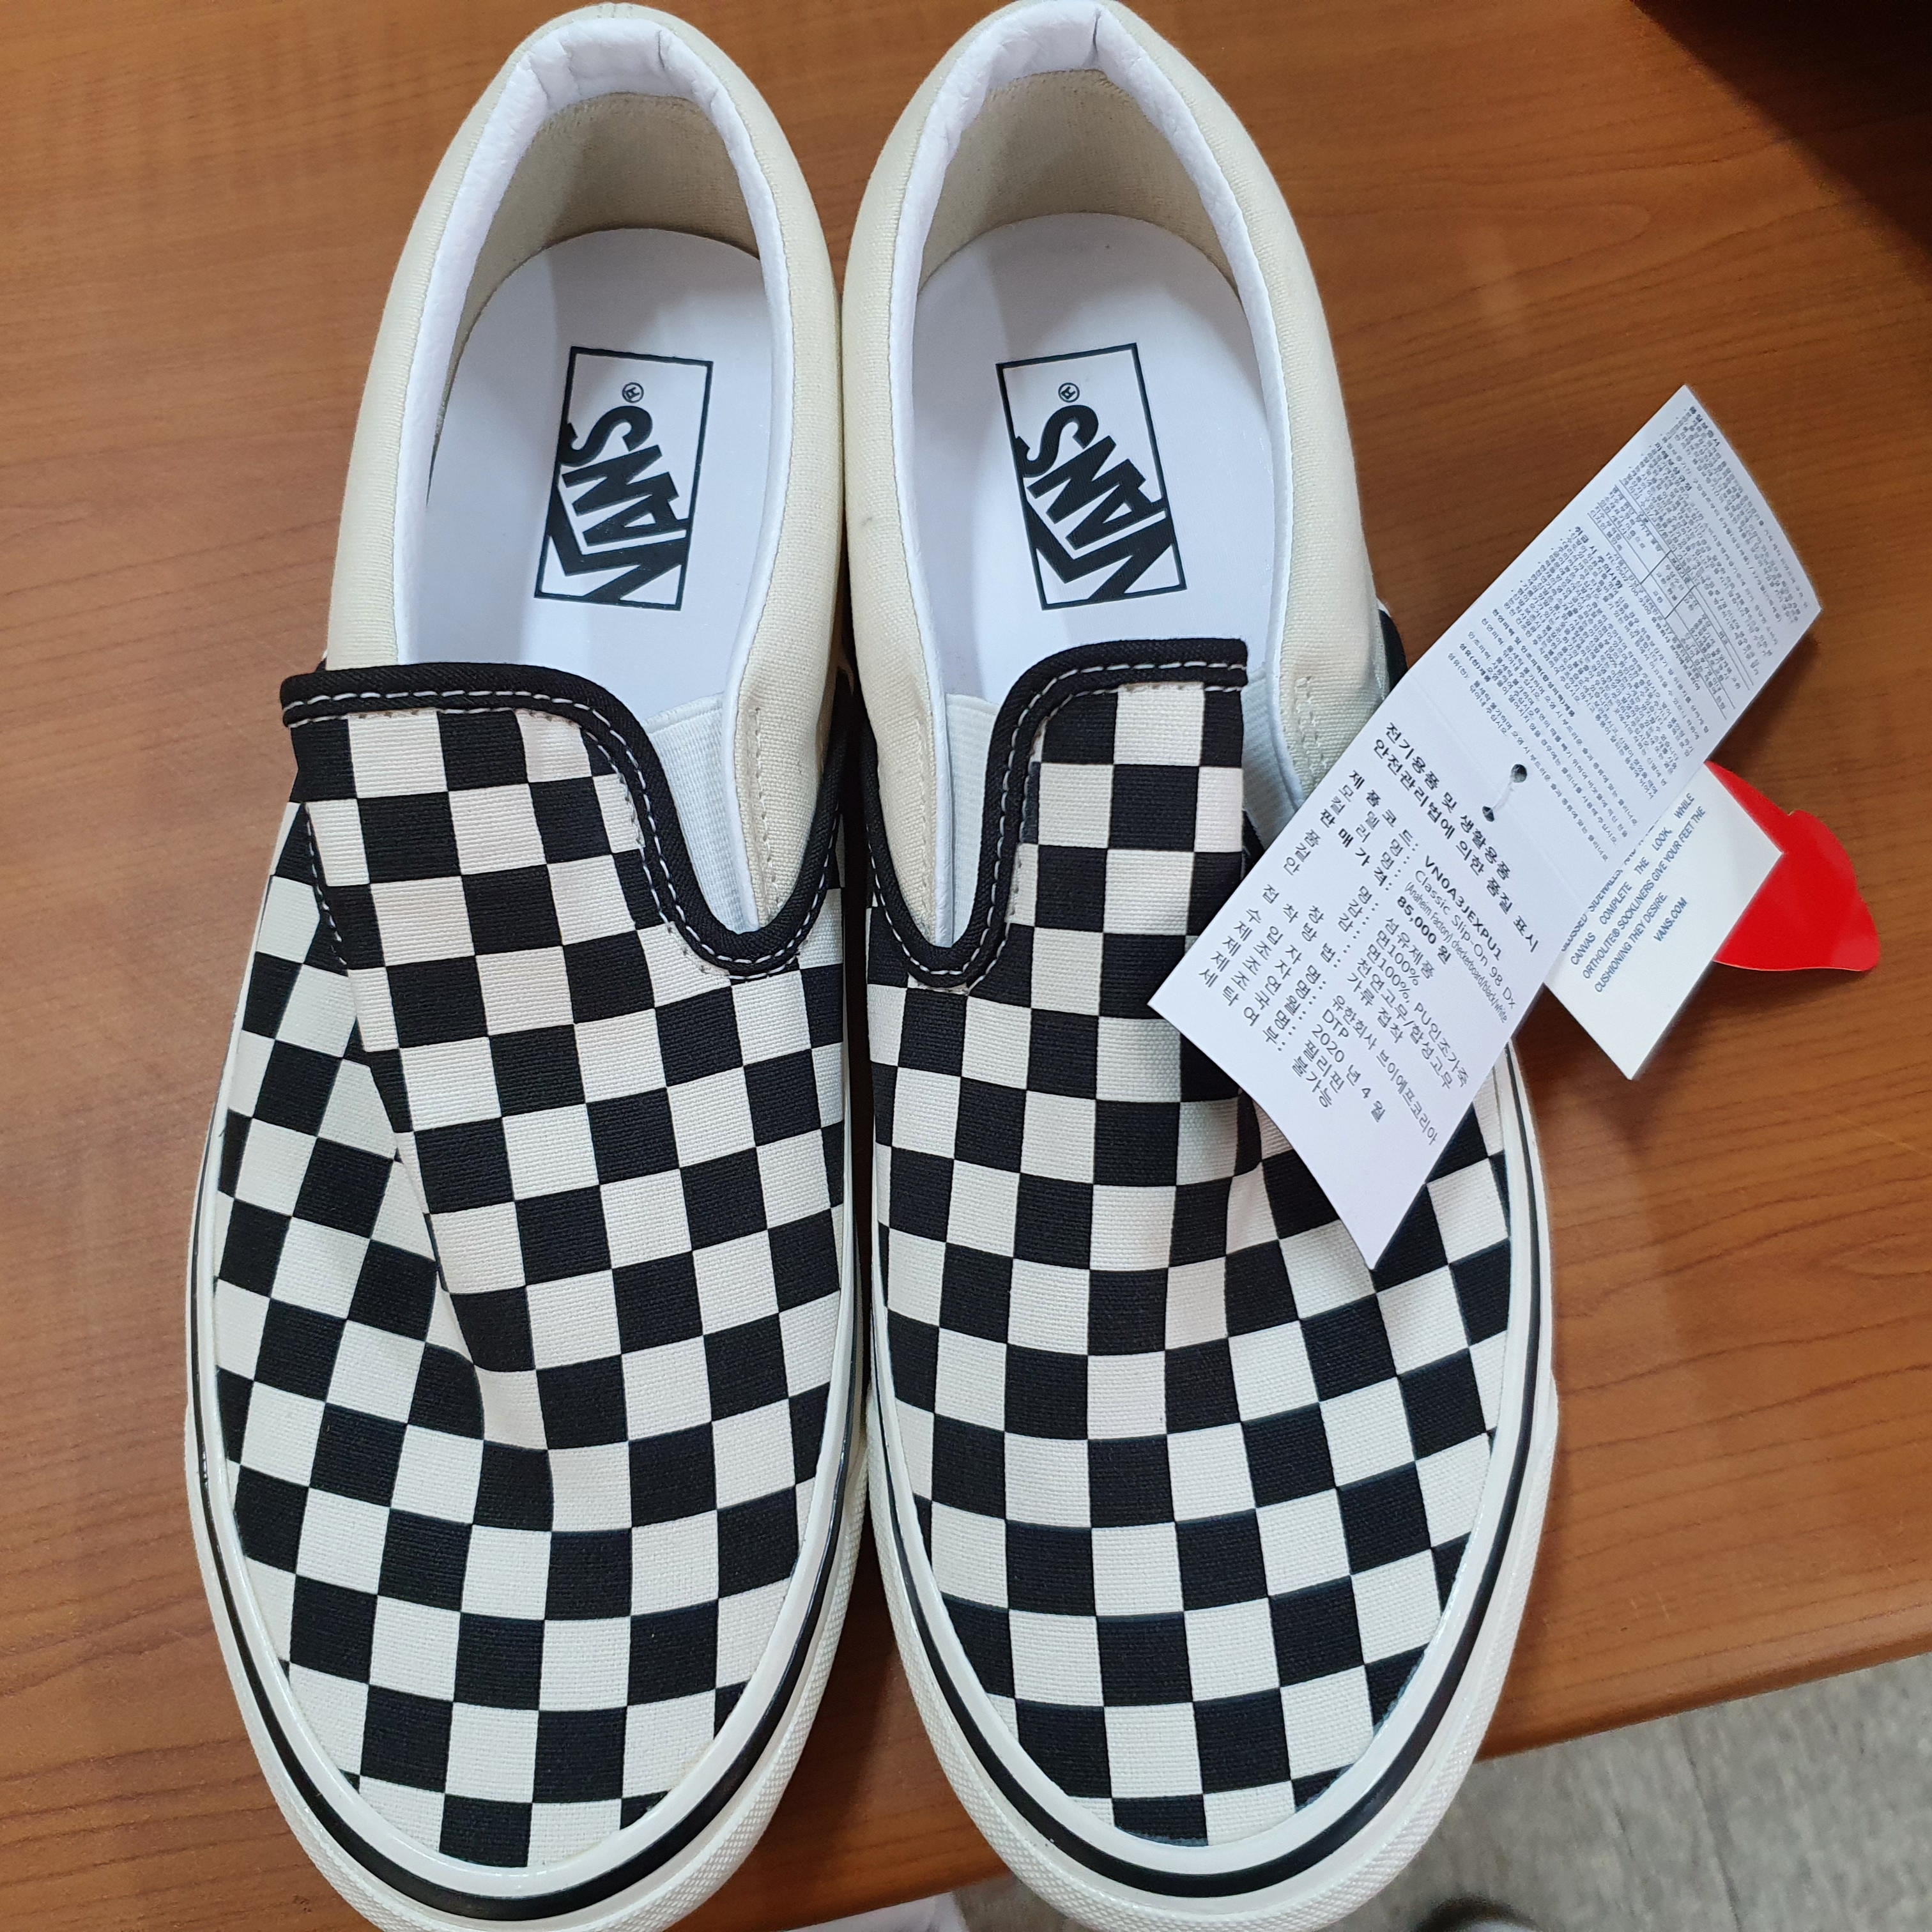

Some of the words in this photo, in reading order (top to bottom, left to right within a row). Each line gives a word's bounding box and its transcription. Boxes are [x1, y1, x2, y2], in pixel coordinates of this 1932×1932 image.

[1589, 546, 1597, 555] 시
[1374, 739, 1455, 839] 안전관리법에
[1455, 840, 1484, 875] 의한
[1486, 877, 1512, 914] 품질
[1513, 915, 1538, 952] 표시
[1386, 722, 1439, 790] 전기용품
[1441, 792, 1457, 813] 및
[1460, 815, 1510, 880] 생활용품
[1404, 882, 1432, 916] (Anaheim
[1430, 912, 1453, 942] Factory)
[1425, 855, 1501, 960] VN0A3JEXPU1
[1570, 932, 1595, 965] CANVAS
[1599, 881, 1632, 924] COMPLETE
[1634, 856, 1649, 874] THE
[1652, 827, 1672, 850] LOOK,
[1673, 792, 1694, 818] WHILE
[1617, 879, 1654, 930] SOCKLINERS
[1652, 860, 1667, 881] GIVE
[1663, 840, 1682, 862] YOUR
[1678, 820, 1694, 843] FEET
[1690, 806, 1705, 823] THE
[1376, 930, 1420, 985] 면100%
[1384, 918, 1434, 979] 섬유제품
[1397, 896, 1436, 944] 85,000
[1437, 945, 1451, 964] 원
[1415, 870, 1450, 915] Classic
[1451, 914, 1487, 966] Slip-On
[1489, 966, 1503, 986] 98
[1502, 986, 1515, 1008] Dx
[1594, 941, 1632, 992] CUSHIONING
[1628, 919, 1645, 942] THEY
[1643, 892, 1667, 923] DESIRE.
[1653, 896, 1687, 941] VANS.COM
[1322, 1008, 1349, 1037] DTP
[1347, 972, 1374, 1006] 가류
[1377, 1007, 1403, 1043] 접착
[1357, 958, 1452, 1089] 천연고무/합성고무
[1366, 944, 1410, 1003] 면100%,
[1413, 1002, 1468, 1087] PU인조가죽
[1292, 1055, 1331, 1107] 불가능
[1303, 1039, 1344, 1093] 필리핀
[1311, 1023, 1344, 1062] 2020
[1346, 1064, 1361, 1086] 년
[1361, 1087, 1370, 1098] 4
[1370, 1100, 1385, 1122] 월
[1332, 995, 1377, 1050] 유한회사
[1376, 1049, 1438, 1145] 브이에프코리아
